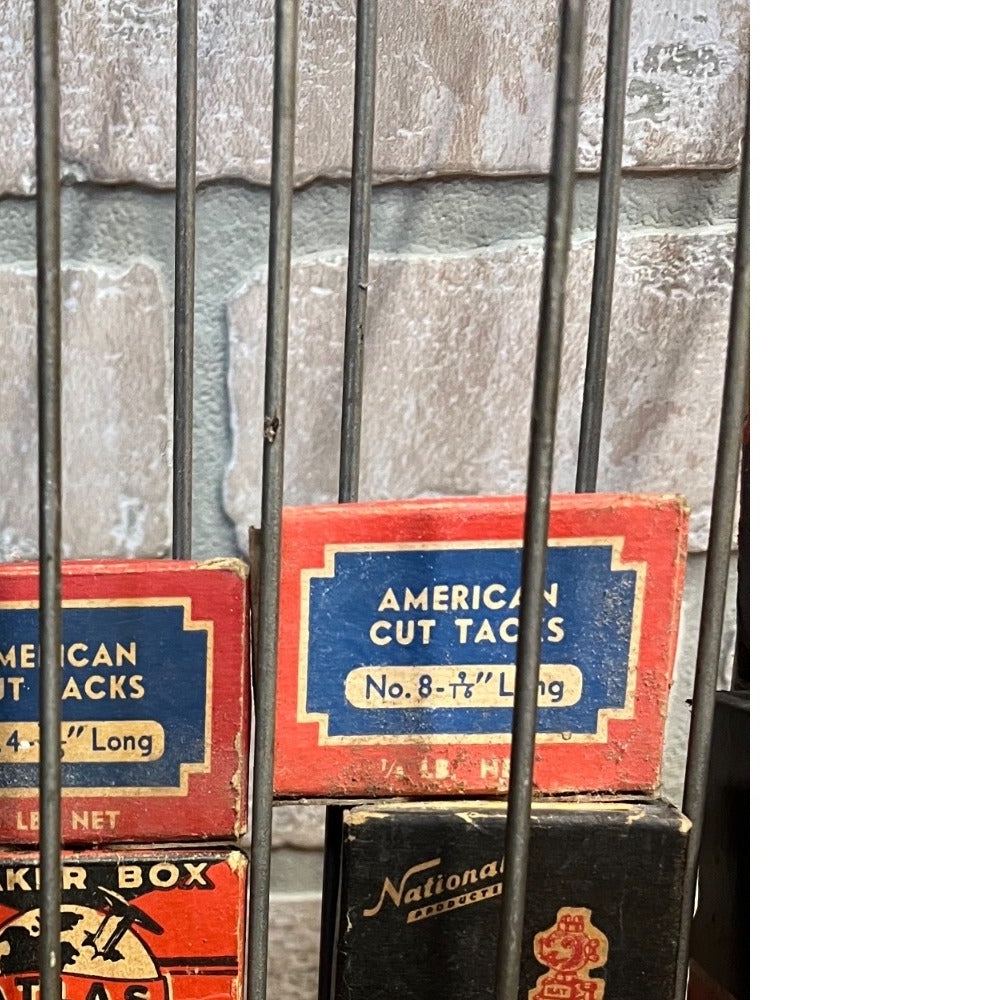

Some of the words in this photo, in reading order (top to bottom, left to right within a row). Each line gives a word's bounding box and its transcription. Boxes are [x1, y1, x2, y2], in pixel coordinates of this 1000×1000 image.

[369, 618, 436, 646] CUT
[454, 616, 565, 644] TACS
[61, 674, 146, 701] ACKS
[365, 674, 411, 701] No.
[92, 726, 154, 757] Long
[71, 809, 121, 831] NET
[118, 862, 209, 889] BOX
